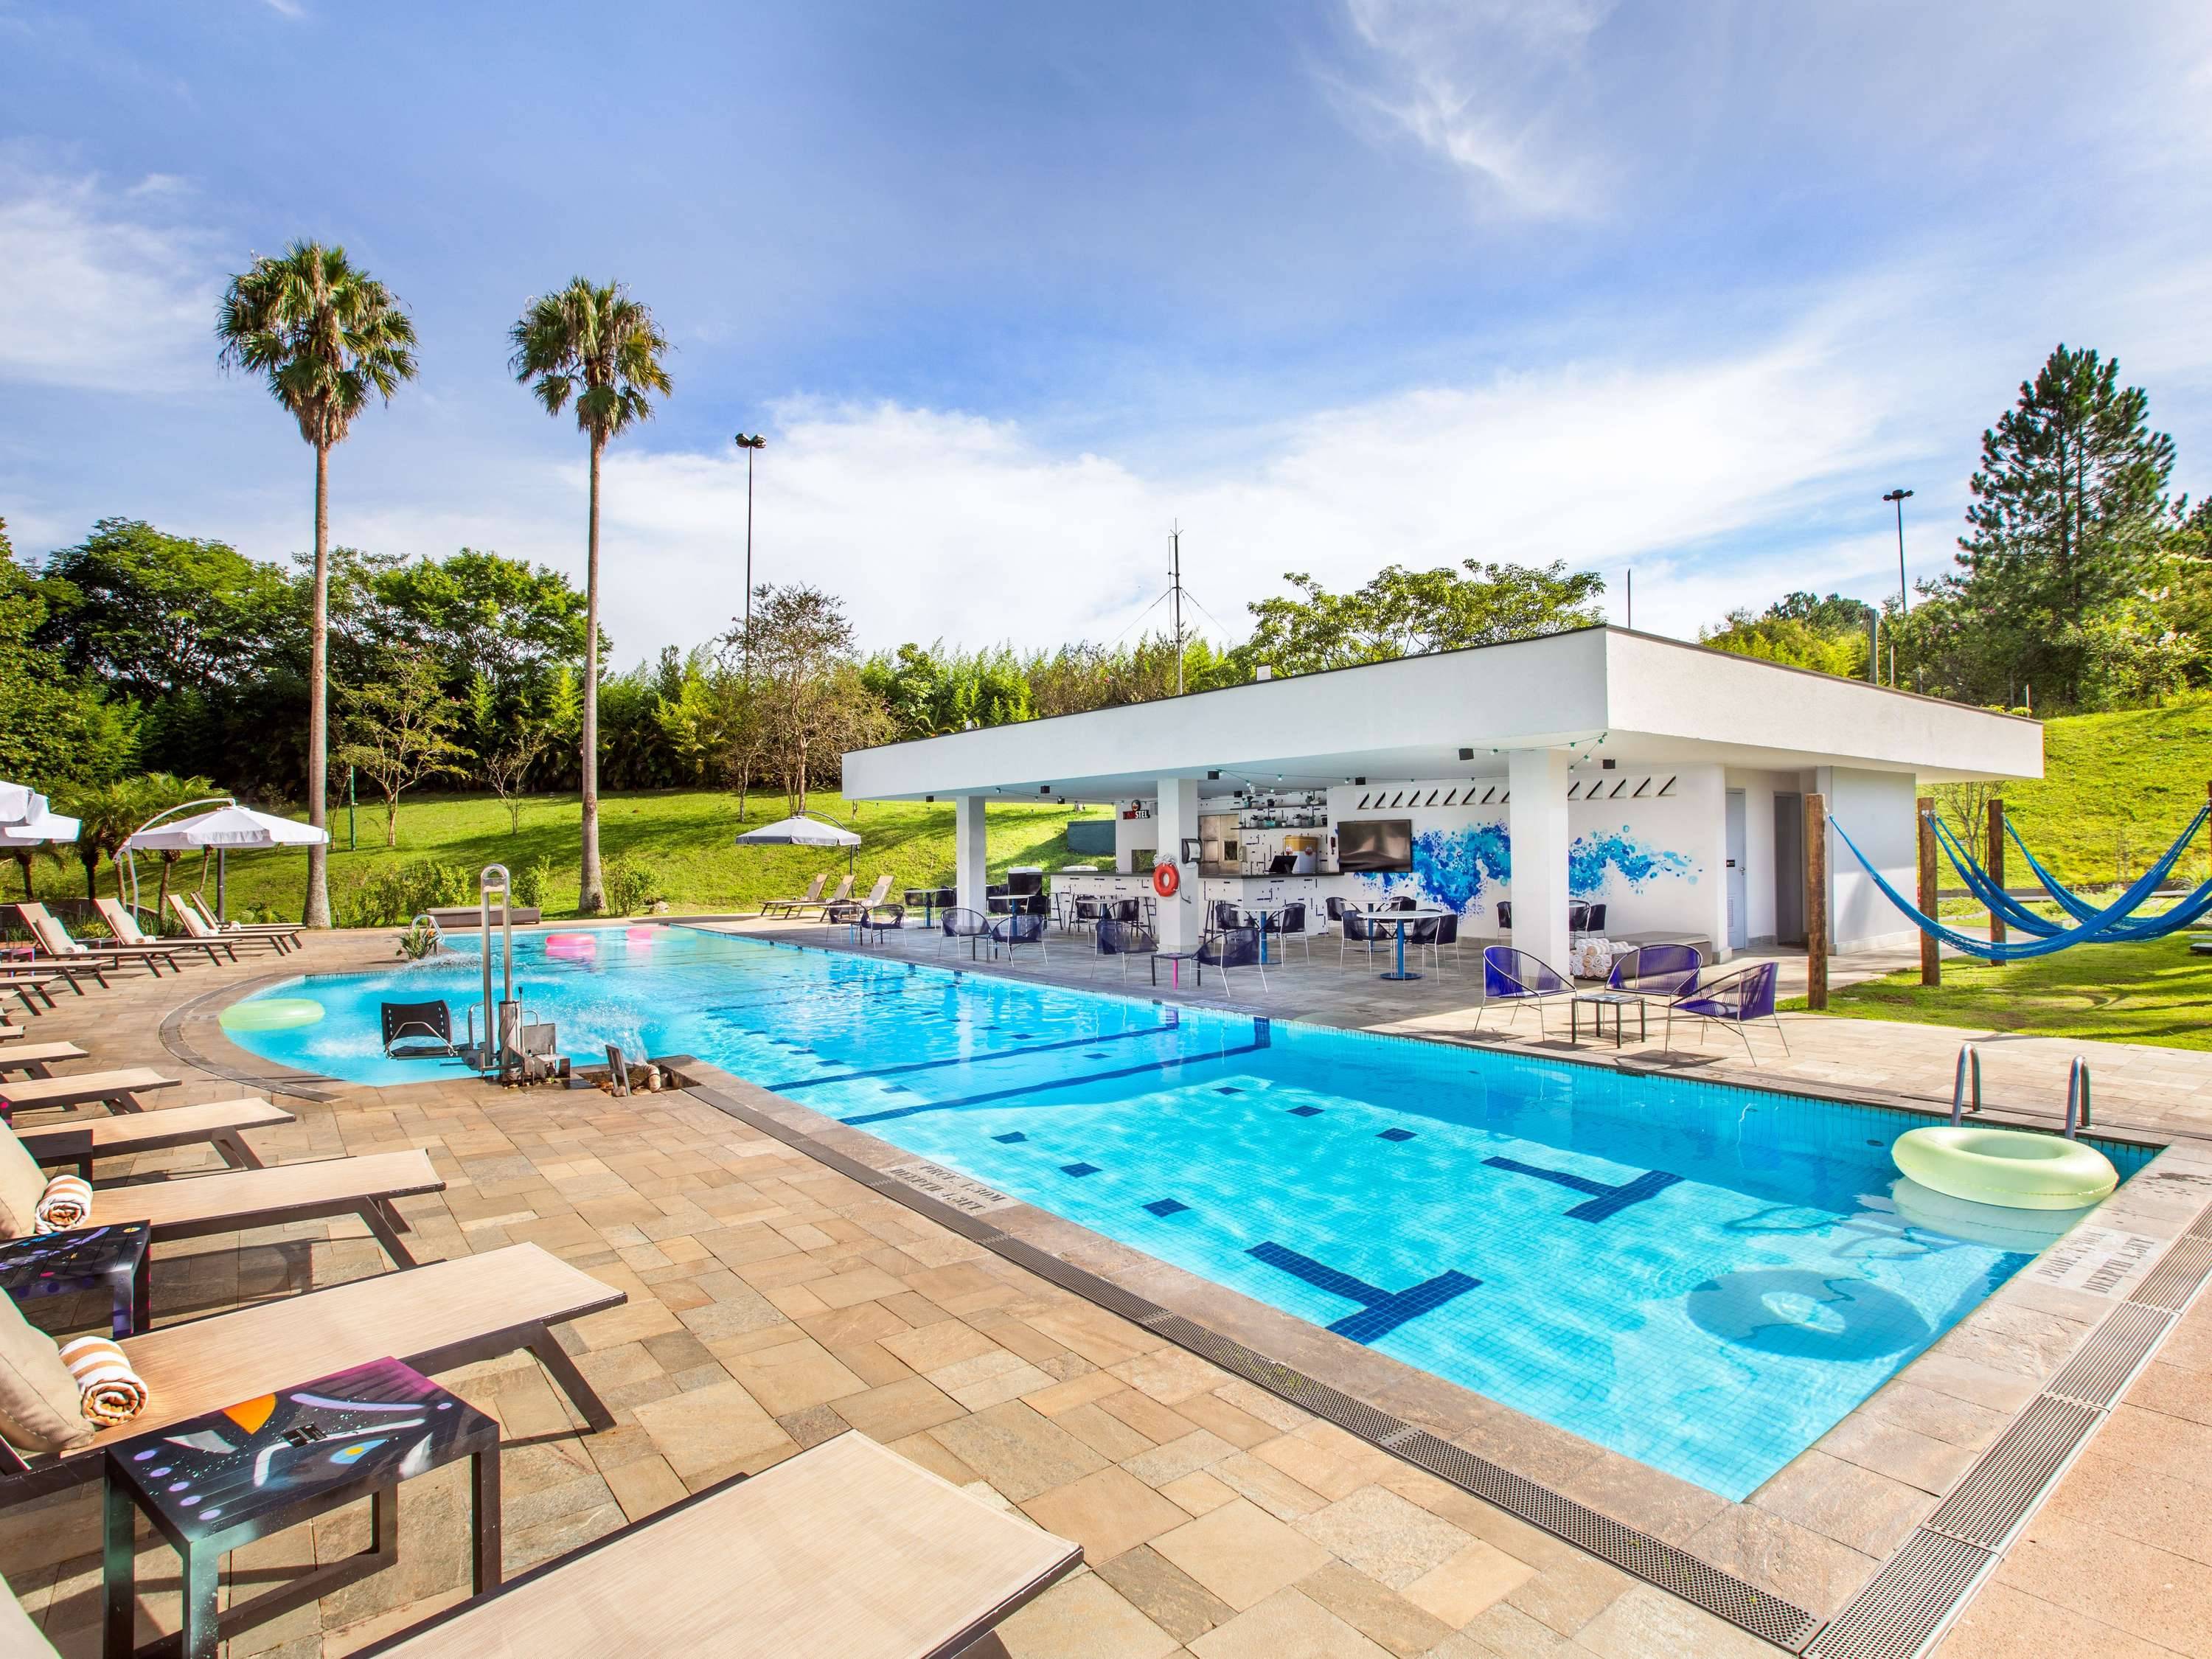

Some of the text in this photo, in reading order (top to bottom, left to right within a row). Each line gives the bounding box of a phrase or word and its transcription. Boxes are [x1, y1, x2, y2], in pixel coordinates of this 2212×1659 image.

[1122, 810, 1148, 819] MSTEL
[890, 1168, 944, 1192] DEEPTH
[919, 1164, 959, 1183] PROF.
[2081, 1258, 2135, 1294] DEEPTH
